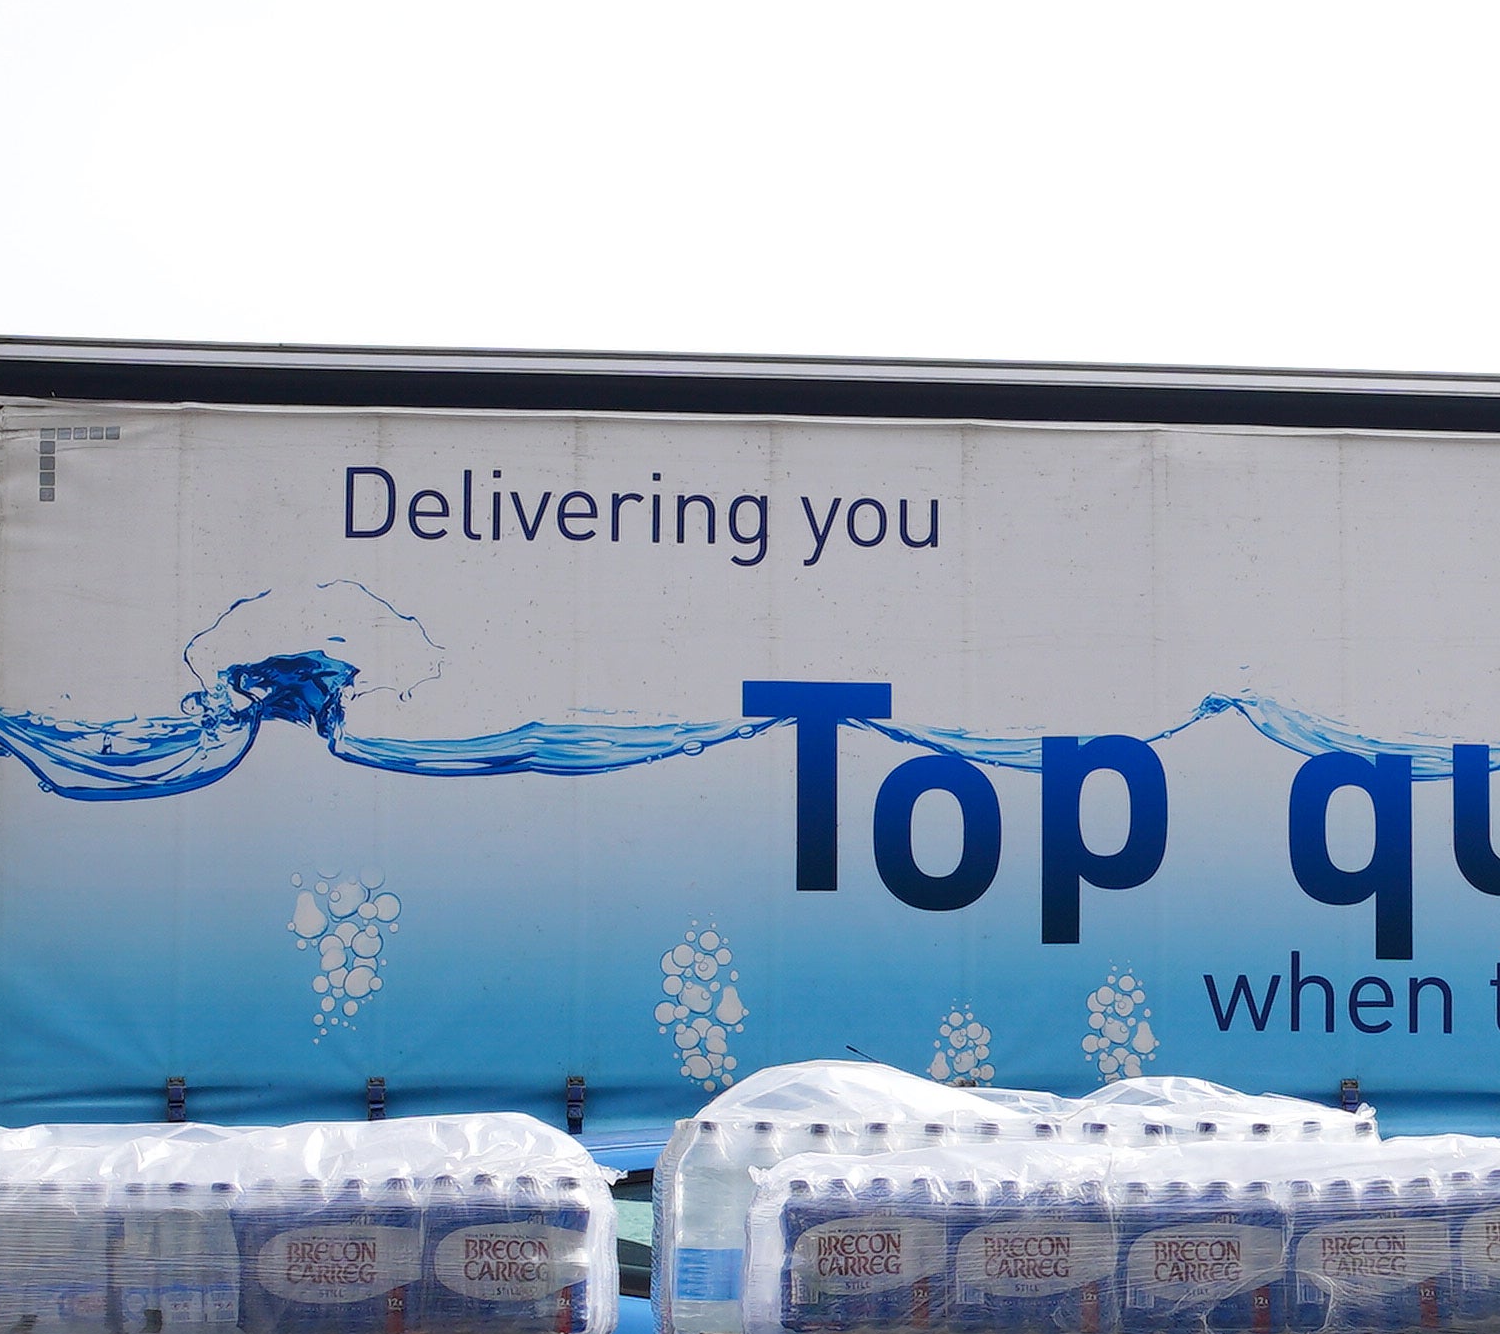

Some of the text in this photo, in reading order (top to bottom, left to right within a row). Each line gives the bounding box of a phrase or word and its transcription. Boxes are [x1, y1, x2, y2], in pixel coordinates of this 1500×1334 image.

[345, 468, 942, 568] Delivering you
[741, 681, 1168, 944] Top
[1203, 955, 1454, 1035] when
[286, 1241, 376, 1263] BRECON
[817, 1234, 900, 1255] BRECON
[984, 1236, 1070, 1257] BRECON
[1154, 1241, 1240, 1261] BRECON
[286, 1264, 378, 1284] CARREG
[817, 1256, 901, 1275] CARREG
[984, 1257, 1071, 1278] CARREG
[1154, 1262, 1242, 1282] CARREG
